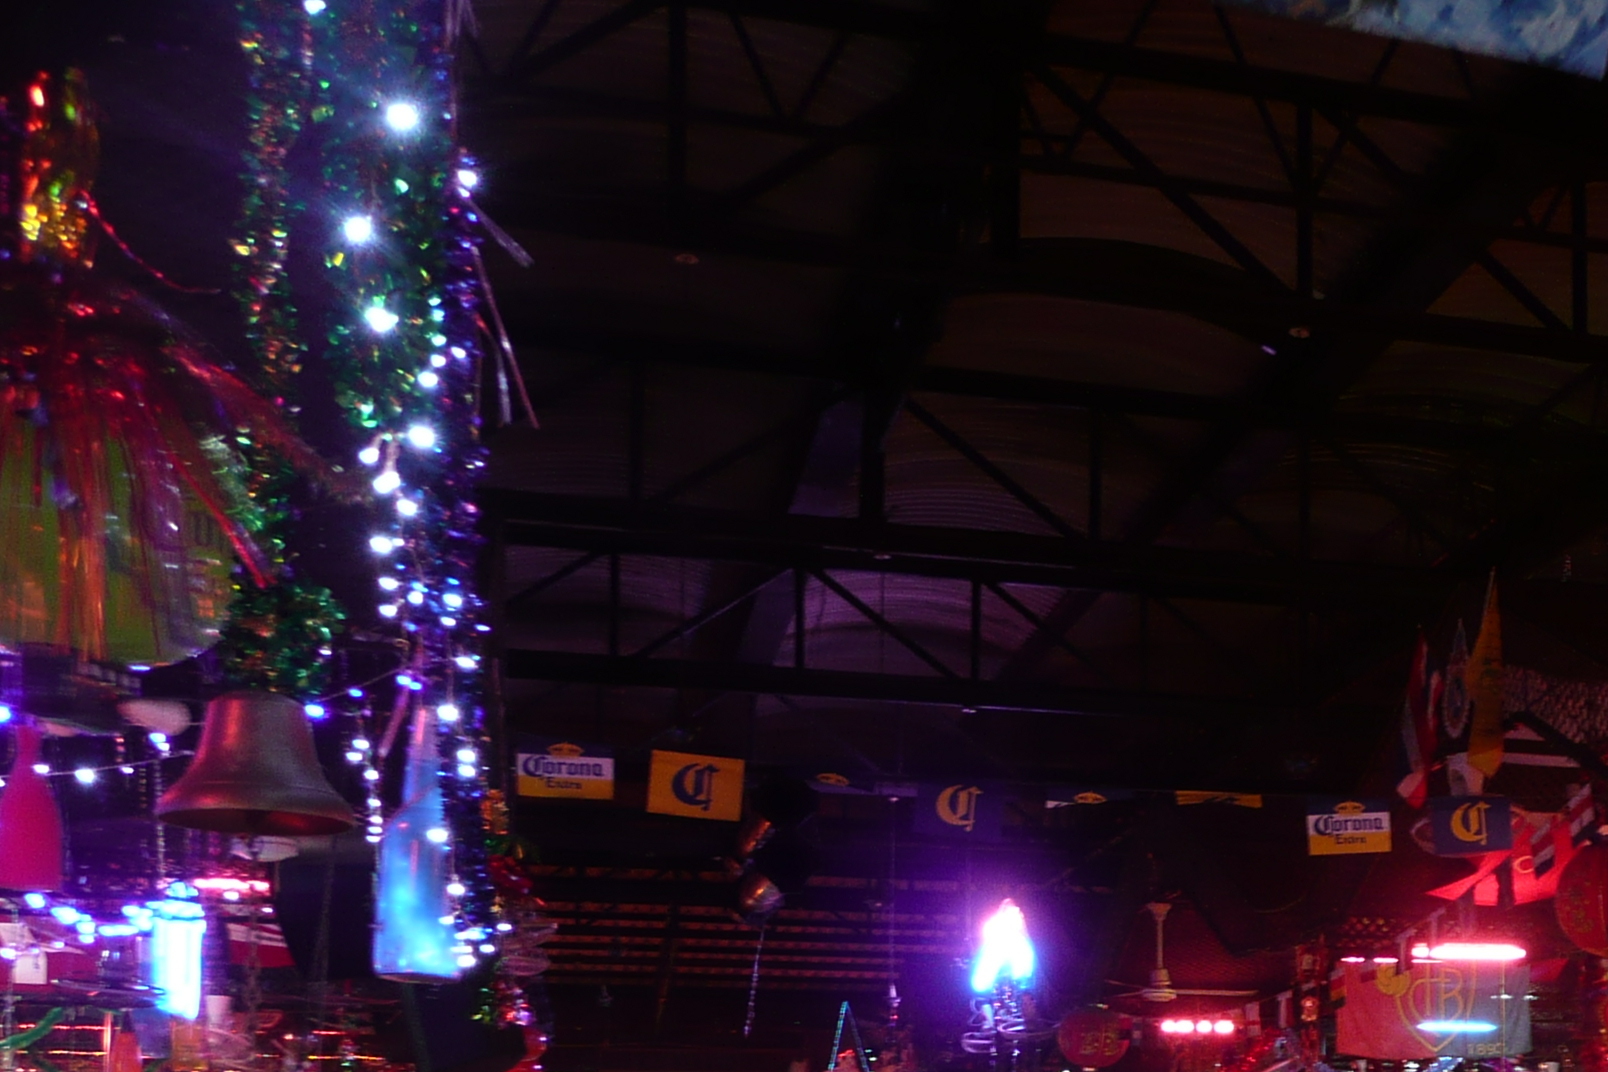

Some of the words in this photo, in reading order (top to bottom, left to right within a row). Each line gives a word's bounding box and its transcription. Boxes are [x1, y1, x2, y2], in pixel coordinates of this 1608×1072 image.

[523, 755, 604, 777] Corona
[546, 777, 582, 789] Extra
[1314, 816, 1384, 835] Corona
[1335, 834, 1367, 844] Extra
